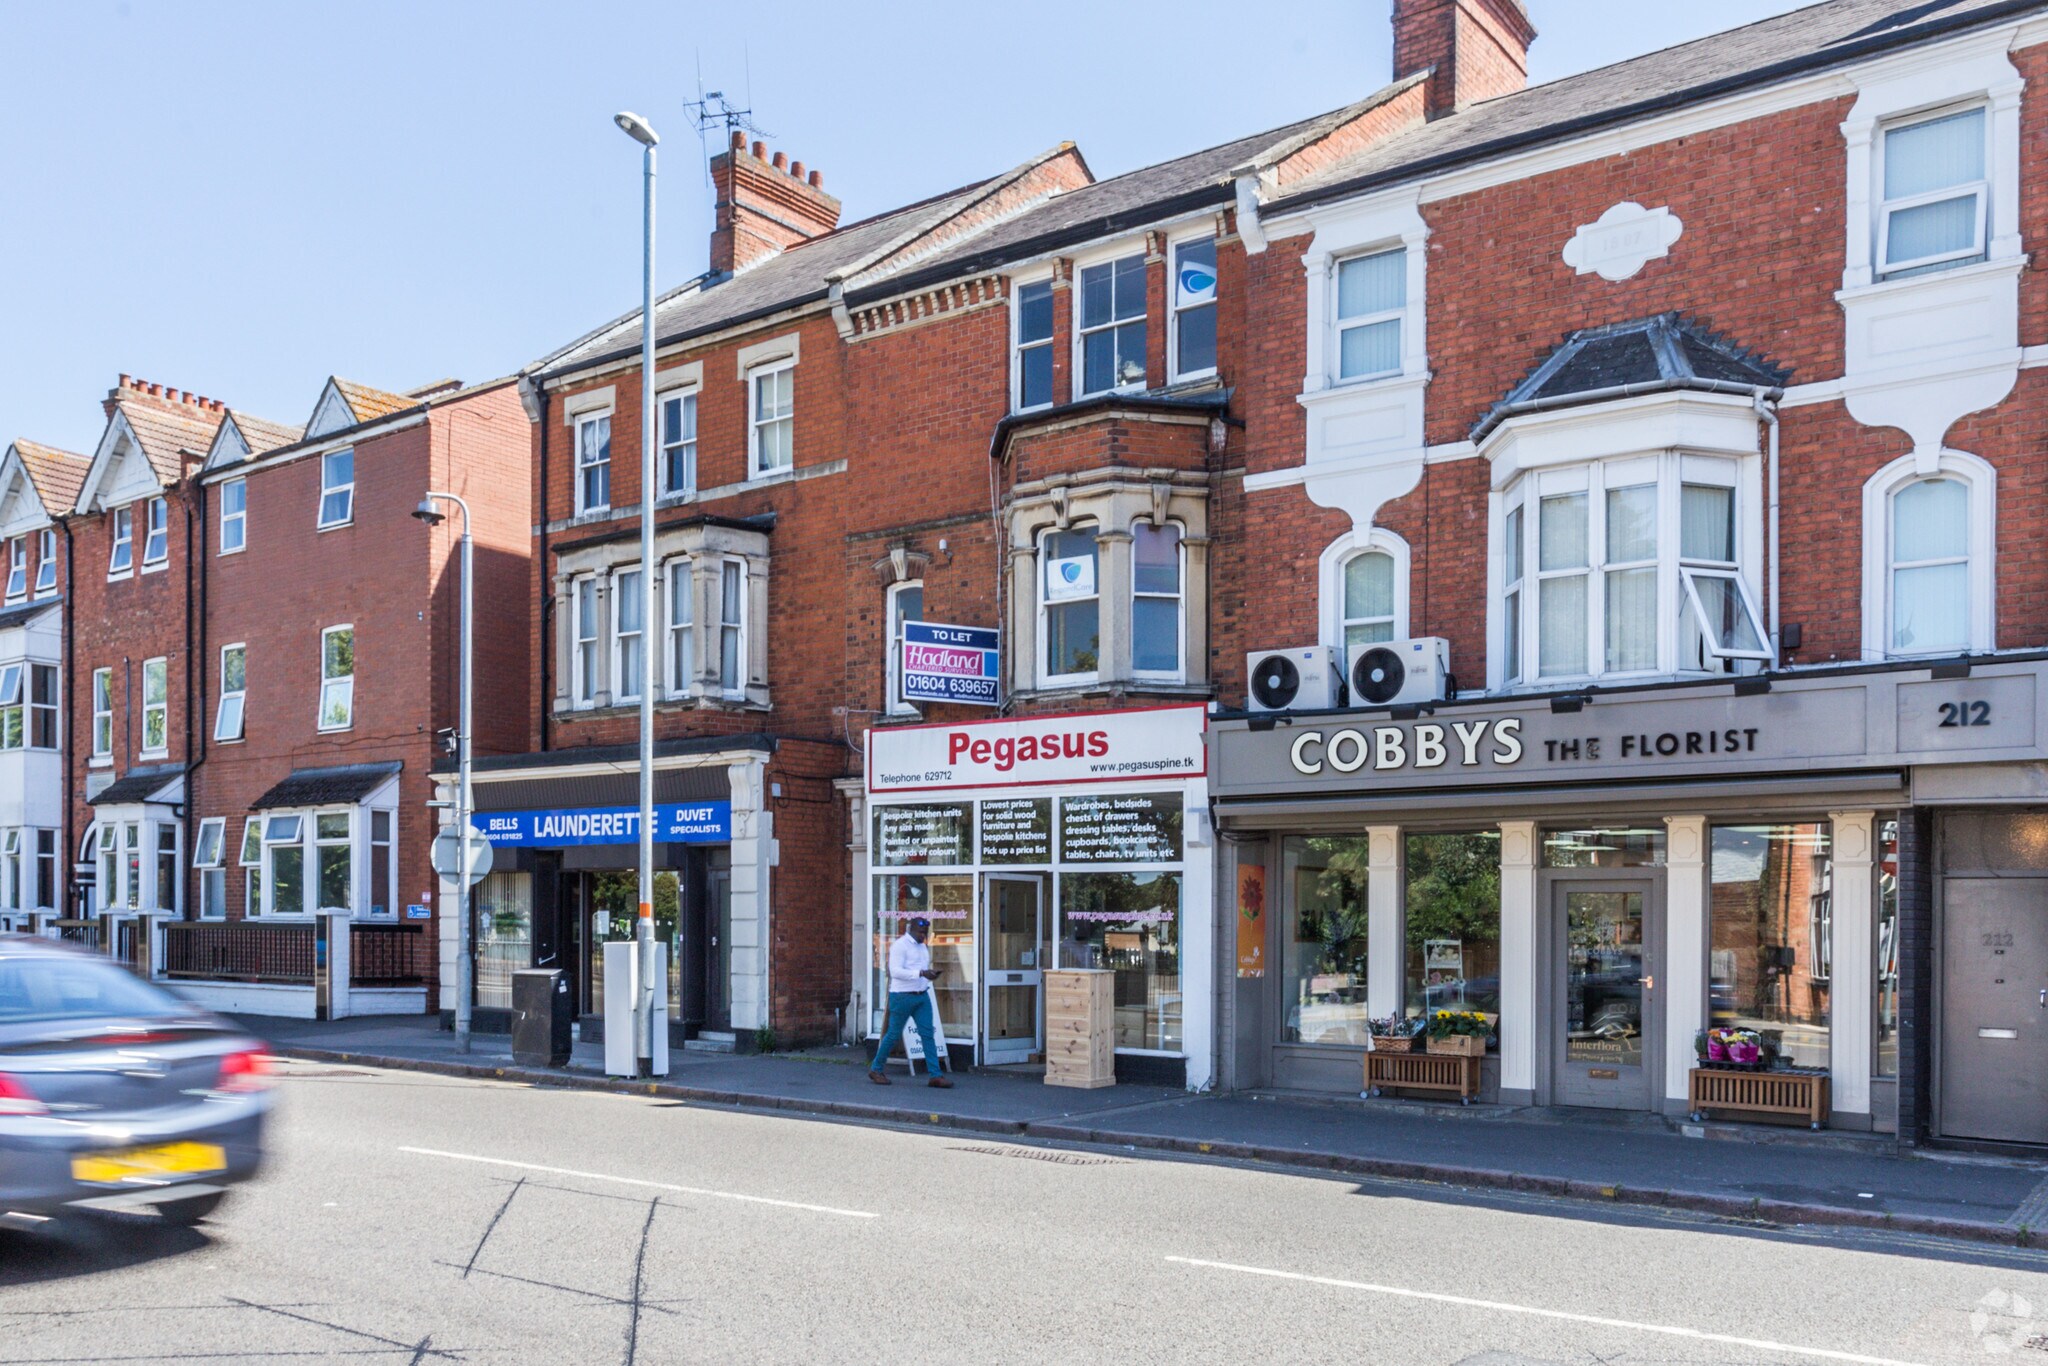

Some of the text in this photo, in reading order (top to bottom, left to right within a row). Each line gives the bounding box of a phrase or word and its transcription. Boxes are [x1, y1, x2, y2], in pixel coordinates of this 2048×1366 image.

[932, 630, 972, 642] TO LET
[909, 646, 980, 669] Hadland
[909, 664, 978, 675] CHARTERED SURVEYORS
[908, 675, 995, 695] 01604 639657
[1938, 700, 1991, 727] 212
[949, 730, 1109, 771] Pegasus
[1290, 718, 1758, 774] COBBYS THE FLORIST
[1090, 757, 1194, 773] www.pegasuspine.tk
[880, 771, 952, 784] Telephone 629712
[983, 800, 1033, 809] Lowest prices
[1066, 799, 1151, 811] Wardrobes, bedsides
[676, 808, 713, 822] DUVET
[883, 808, 962, 822] Bespoke kitchen units
[983, 810, 1036, 820] for solid wood
[1066, 812, 1139, 823] chests of drawers
[489, 818, 518, 831] BELLS
[670, 824, 721, 834] SPECIALISTS
[883, 825, 898, 834] Any
[914, 823, 935, 831] made
[983, 820, 1031, 830] furniture and
[1066, 823, 1156, 836] dressing tables, desks
[883, 837, 910, 845] Painted
[922, 835, 959, 845] unpainted
[983, 831, 1047, 842] bespoke kitchens
[1066, 836, 1157, 848] cupboards, bookcases
[883, 847, 956, 857] Hundreds of colours
[983, 846, 997, 855] Pick
[999, 848, 1008, 856] up
[1016, 846, 1034, 856] price
[1035, 845, 1046, 854] list
[1066, 847, 1174, 860] tables, chairs, tv units etc
[1572, 1039, 1621, 1052] Interflora
